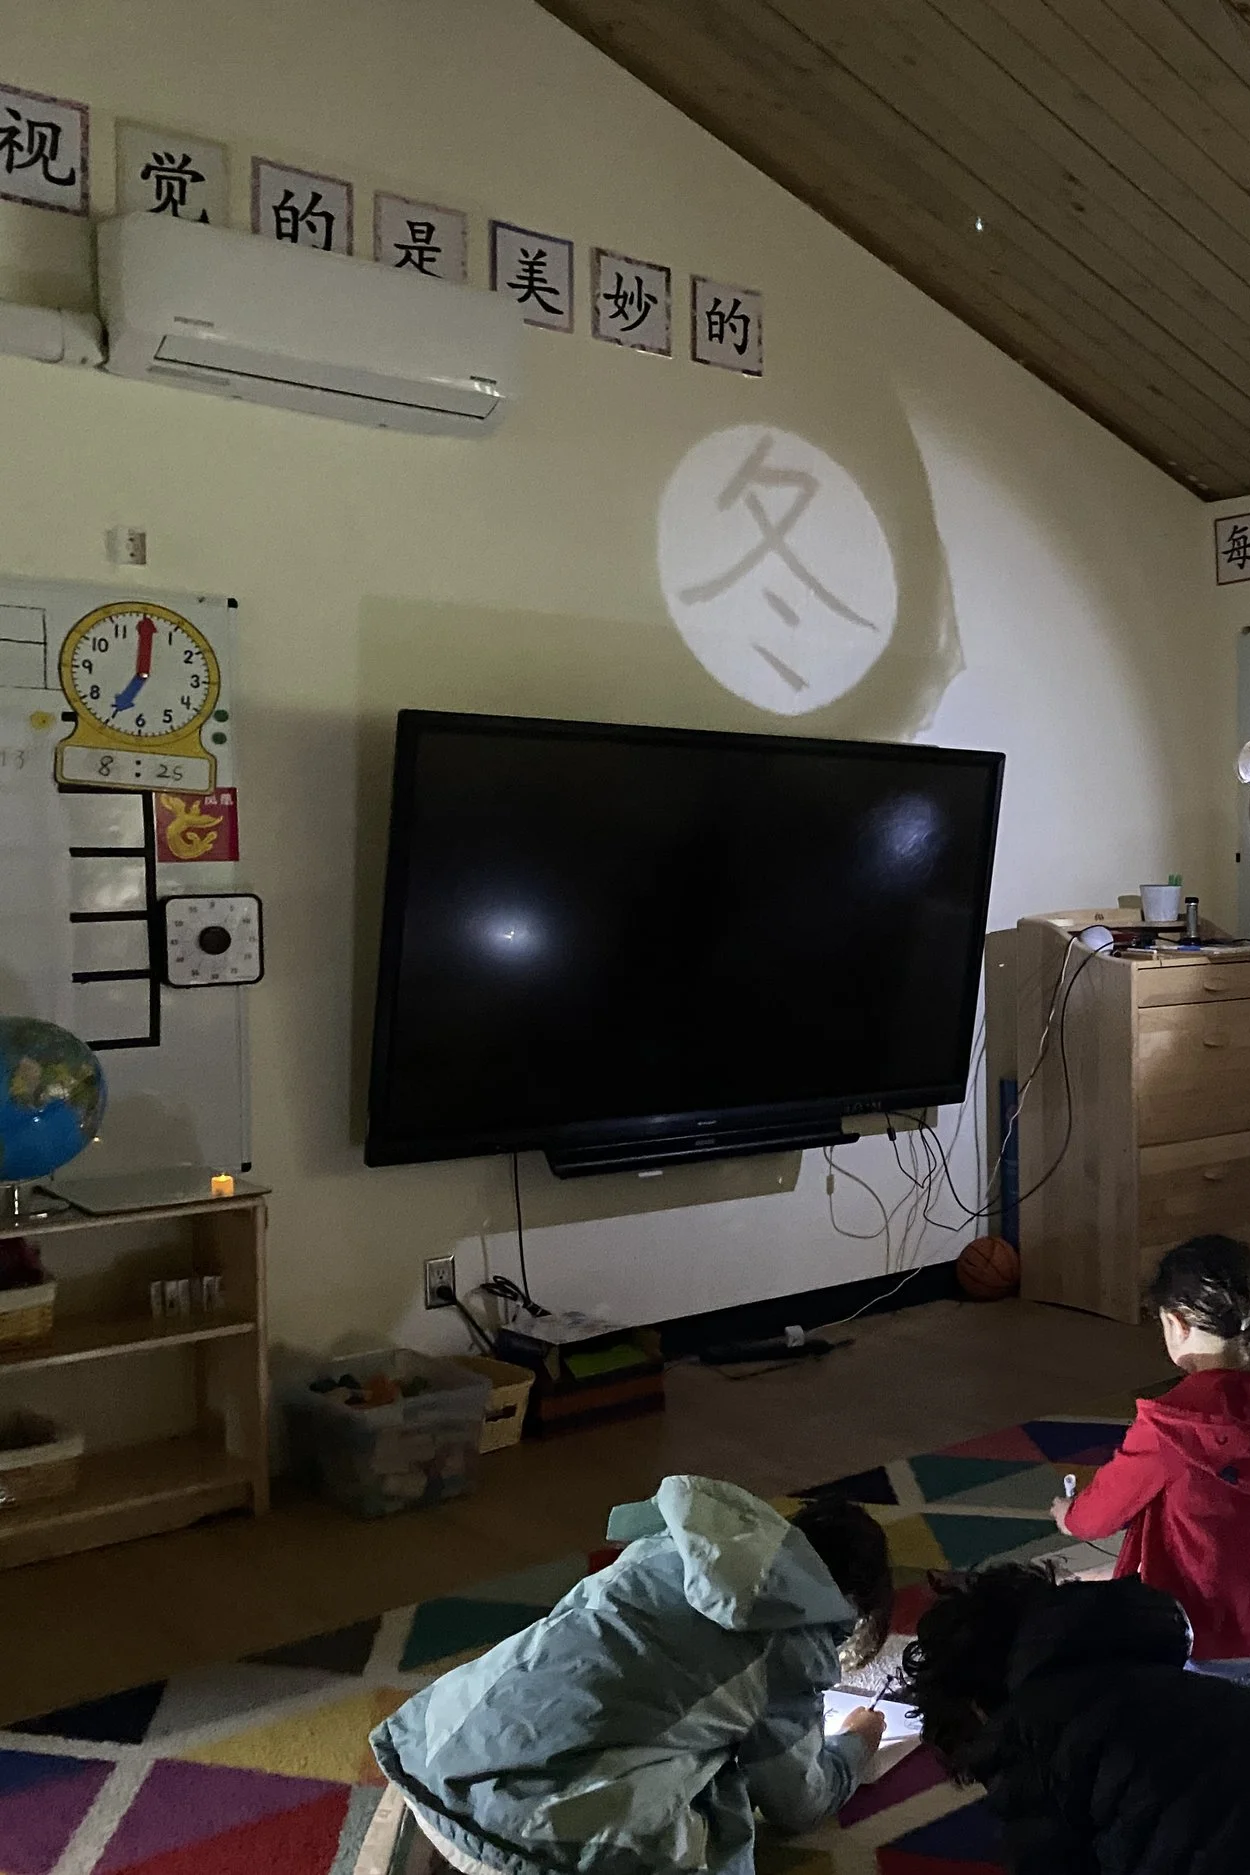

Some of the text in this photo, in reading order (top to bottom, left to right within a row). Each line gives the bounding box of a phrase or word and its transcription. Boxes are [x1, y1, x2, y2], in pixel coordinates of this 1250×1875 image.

[678, 432, 881, 692] 冬
[115, 623, 127, 639] 11
[168, 631, 173, 646] 1
[91, 637, 109, 653] 10
[183, 650, 194, 665] 2
[81, 659, 93, 674] 9
[190, 674, 200, 689] 3
[90, 685, 101, 700] 8
[180, 695, 191, 710] 4
[135, 713, 146, 727] 6
[162, 709, 173, 723] 5
